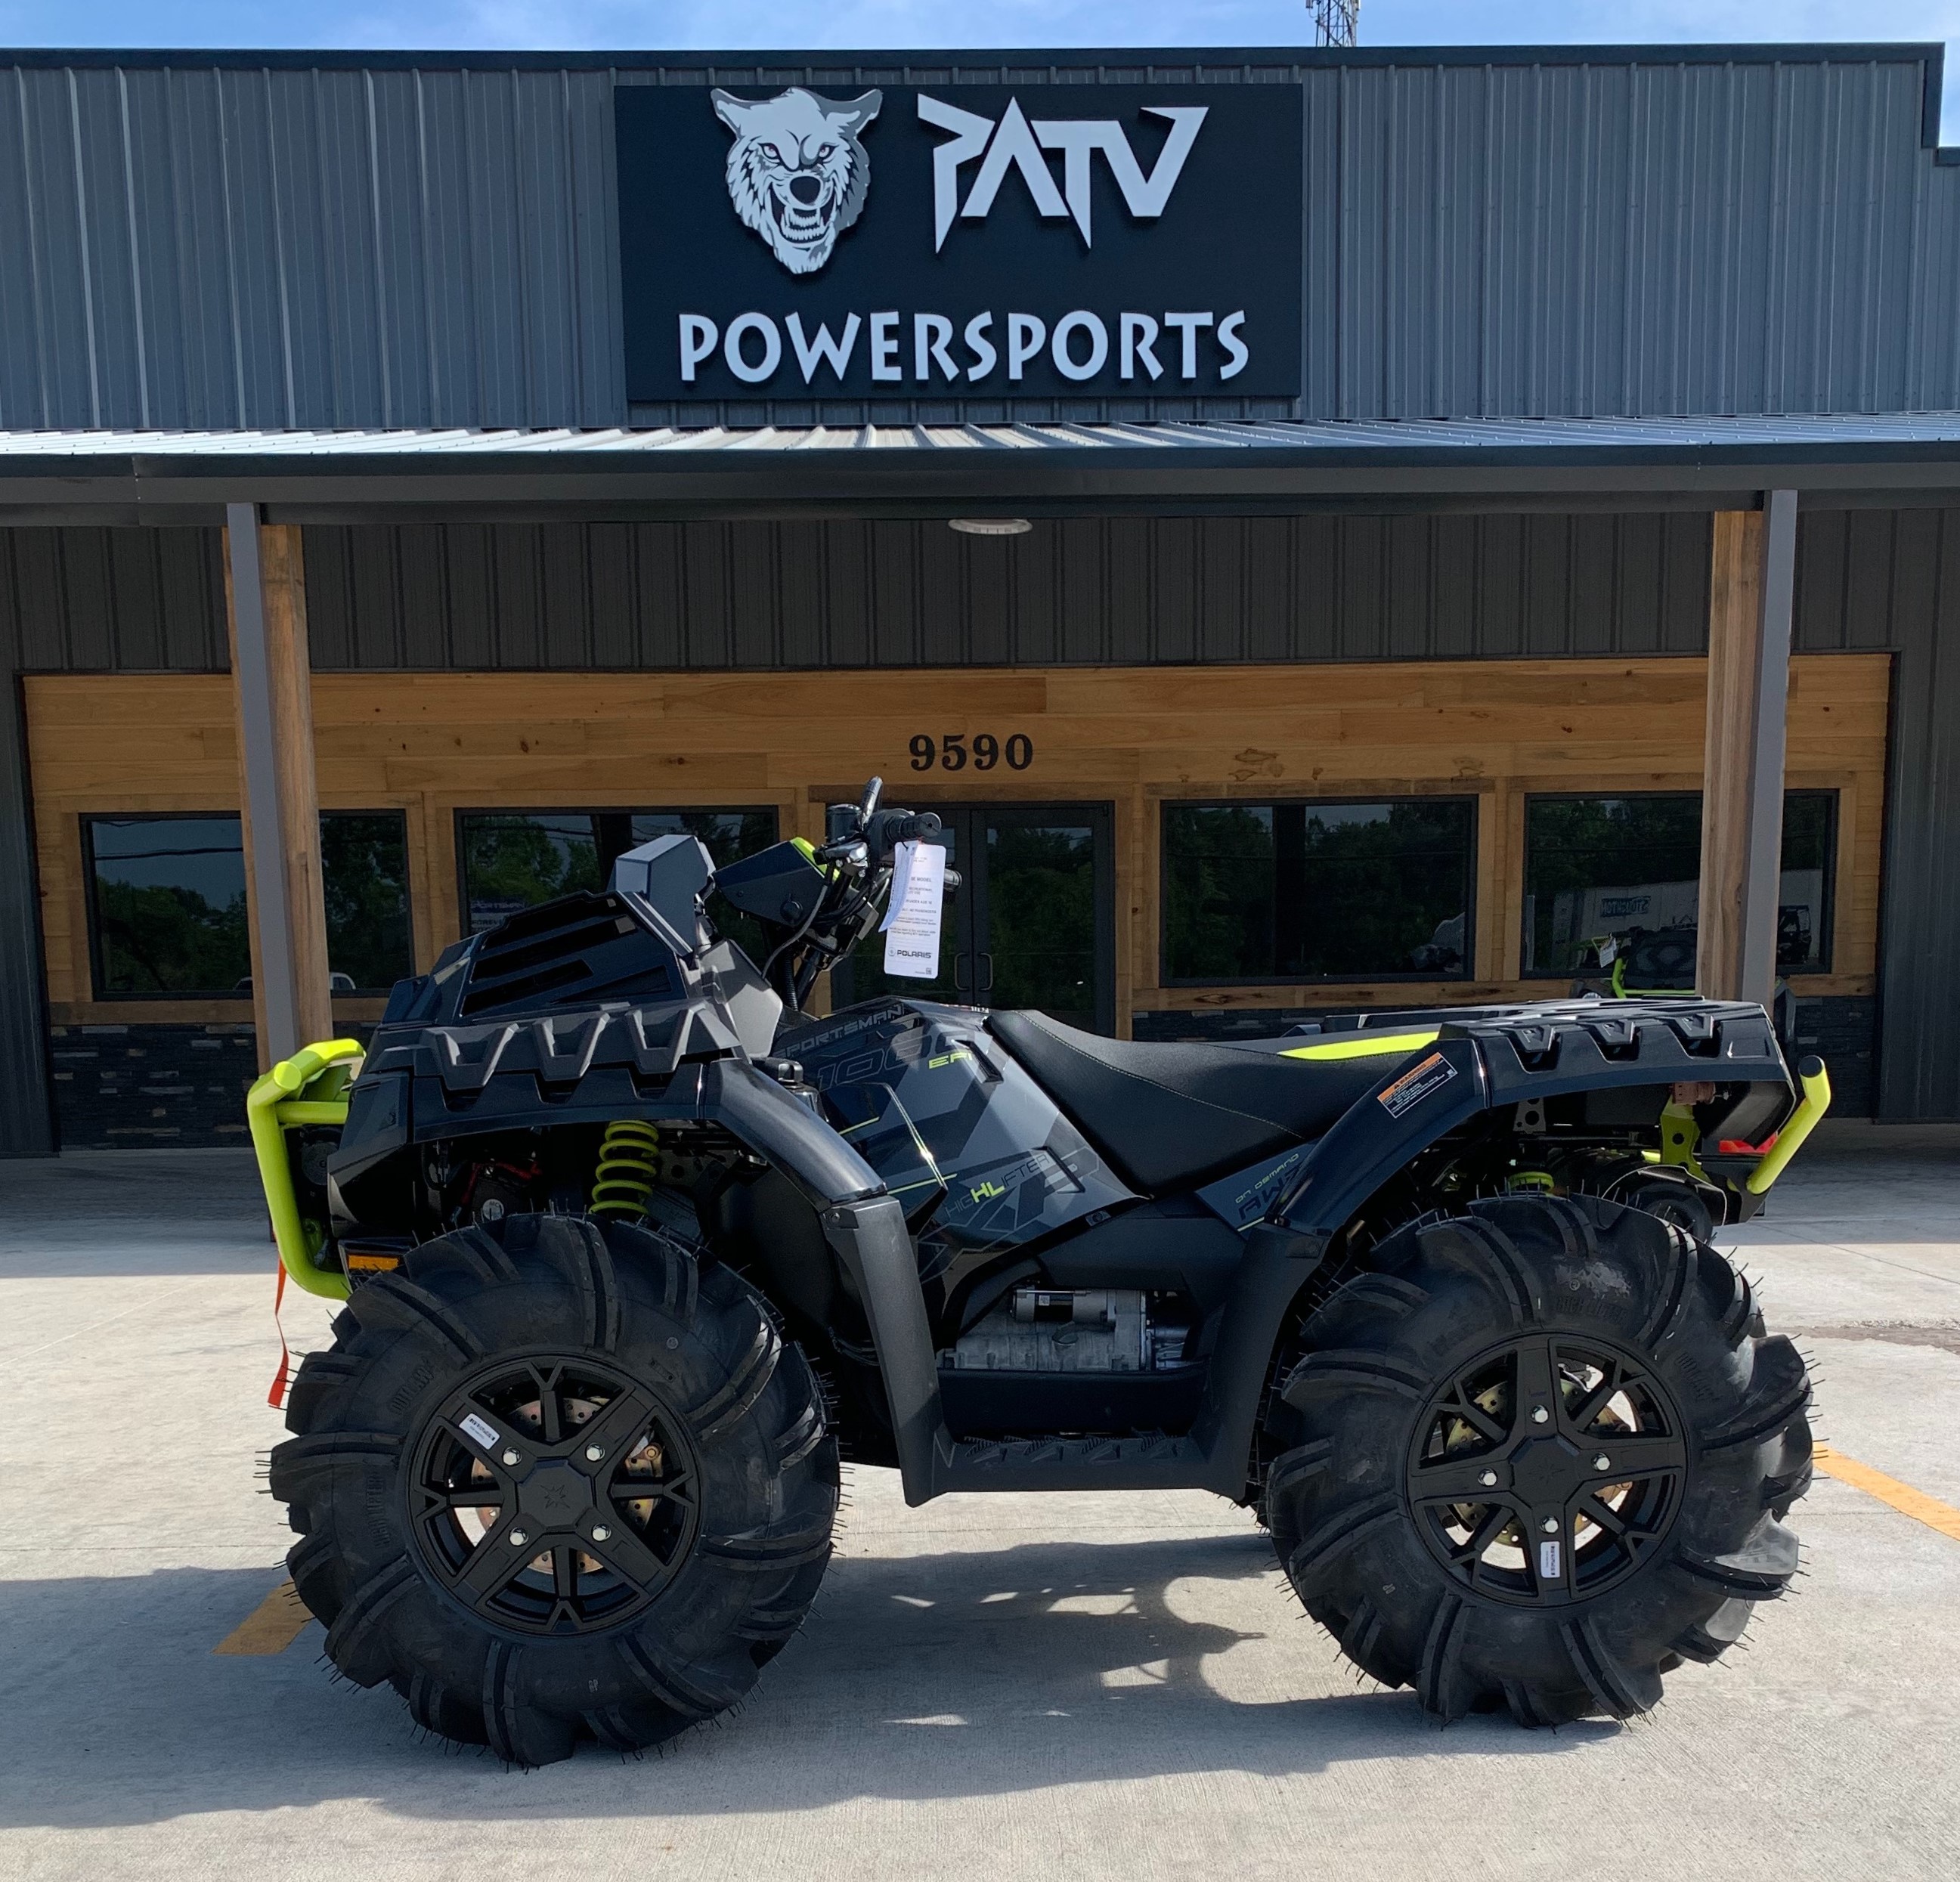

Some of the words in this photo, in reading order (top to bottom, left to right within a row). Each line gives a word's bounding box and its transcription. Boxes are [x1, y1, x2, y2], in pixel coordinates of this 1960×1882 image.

[917, 92, 1210, 254] PATV
[678, 309, 1251, 385] POWERSPORTS
[909, 733, 1034, 771] 9590
[896, 949, 932, 959] POLARIS
[773, 1004, 904, 1058] SPORTSMAN
[929, 1051, 973, 1069] EFI
[1399, 1063, 1427, 1085] WARNING
